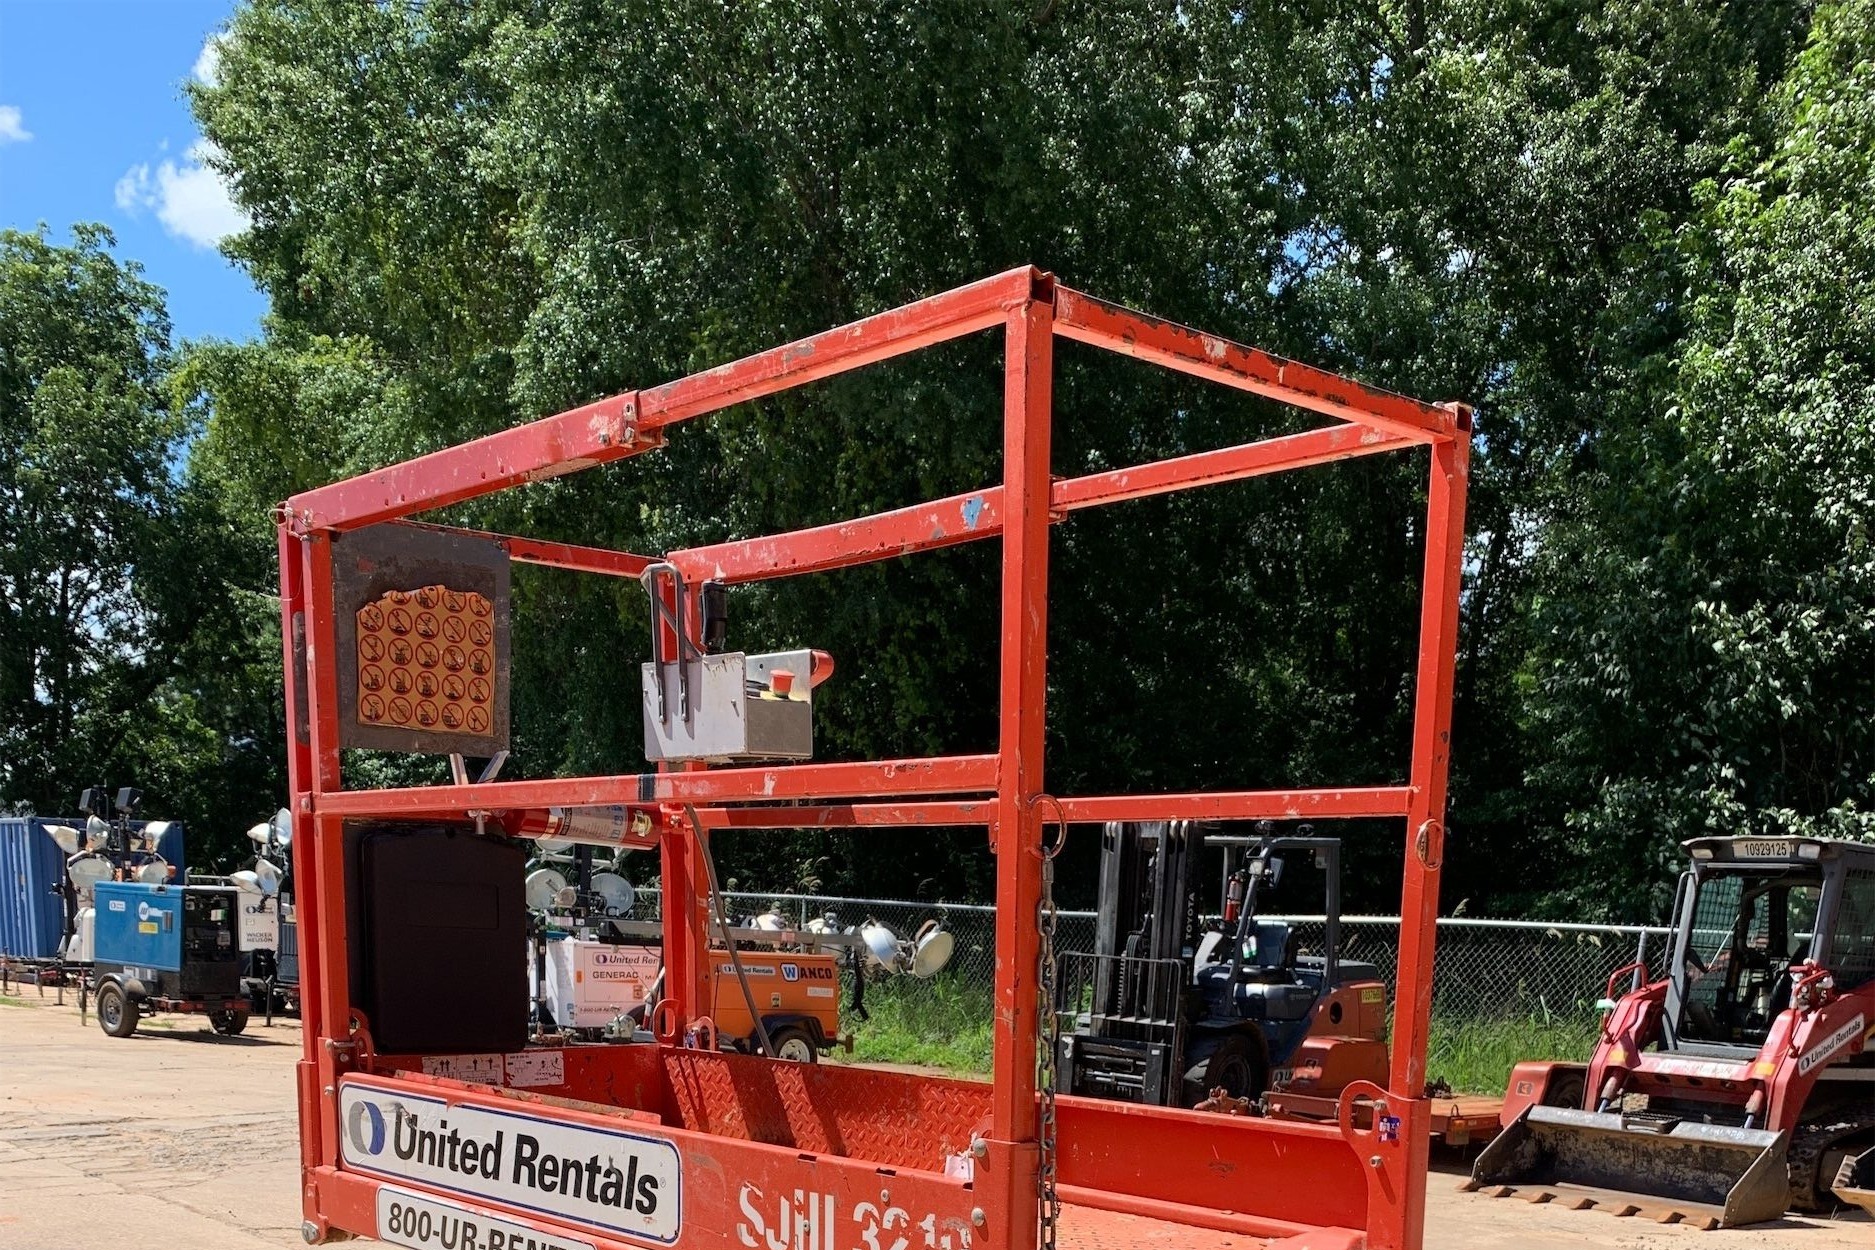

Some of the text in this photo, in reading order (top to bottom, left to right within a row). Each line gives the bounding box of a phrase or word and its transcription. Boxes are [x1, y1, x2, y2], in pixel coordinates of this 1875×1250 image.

[1745, 843, 1787, 856] 10929125
[1185, 892, 1195, 940] TOYOTA
[609, 954, 640, 964] United
[592, 971, 639, 979] GENERAC
[782, 965, 833, 980] WANCO
[1811, 1020, 1861, 1063] United Rentals
[393, 1110, 659, 1215] United Rentals
